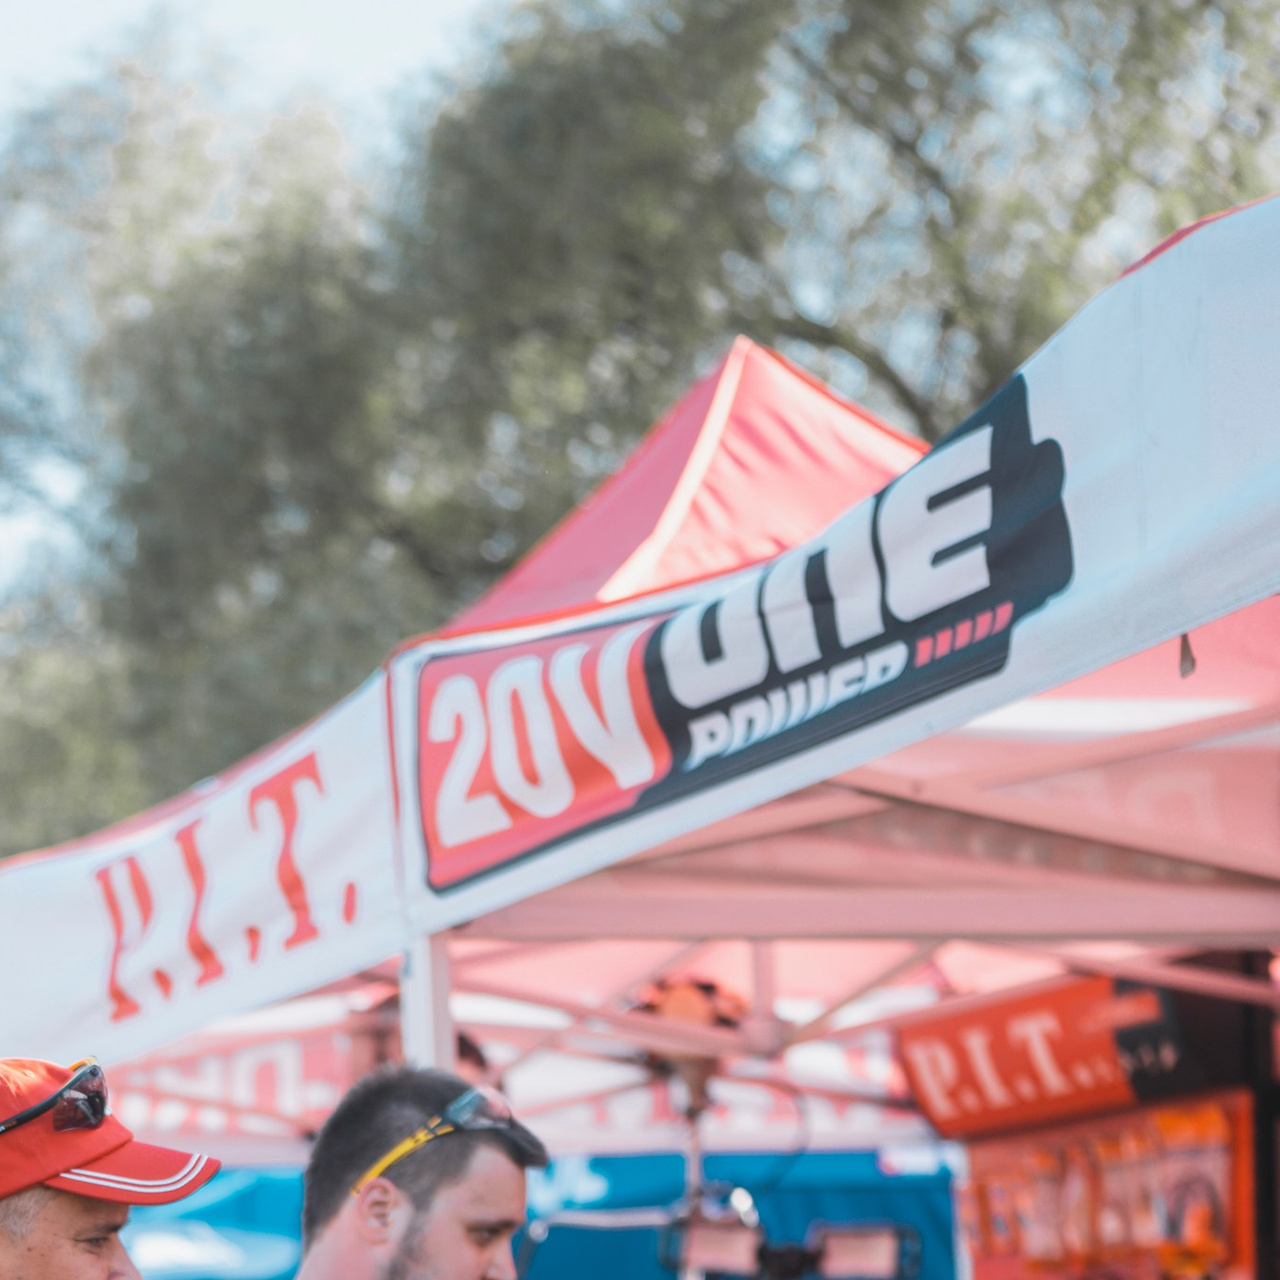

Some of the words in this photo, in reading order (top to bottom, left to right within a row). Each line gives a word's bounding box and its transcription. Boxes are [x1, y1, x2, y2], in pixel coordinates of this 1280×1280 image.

[428, 621, 655, 848] 20V
[683, 640, 908, 772] POWER
[96, 752, 356, 1022] P.I.T.
